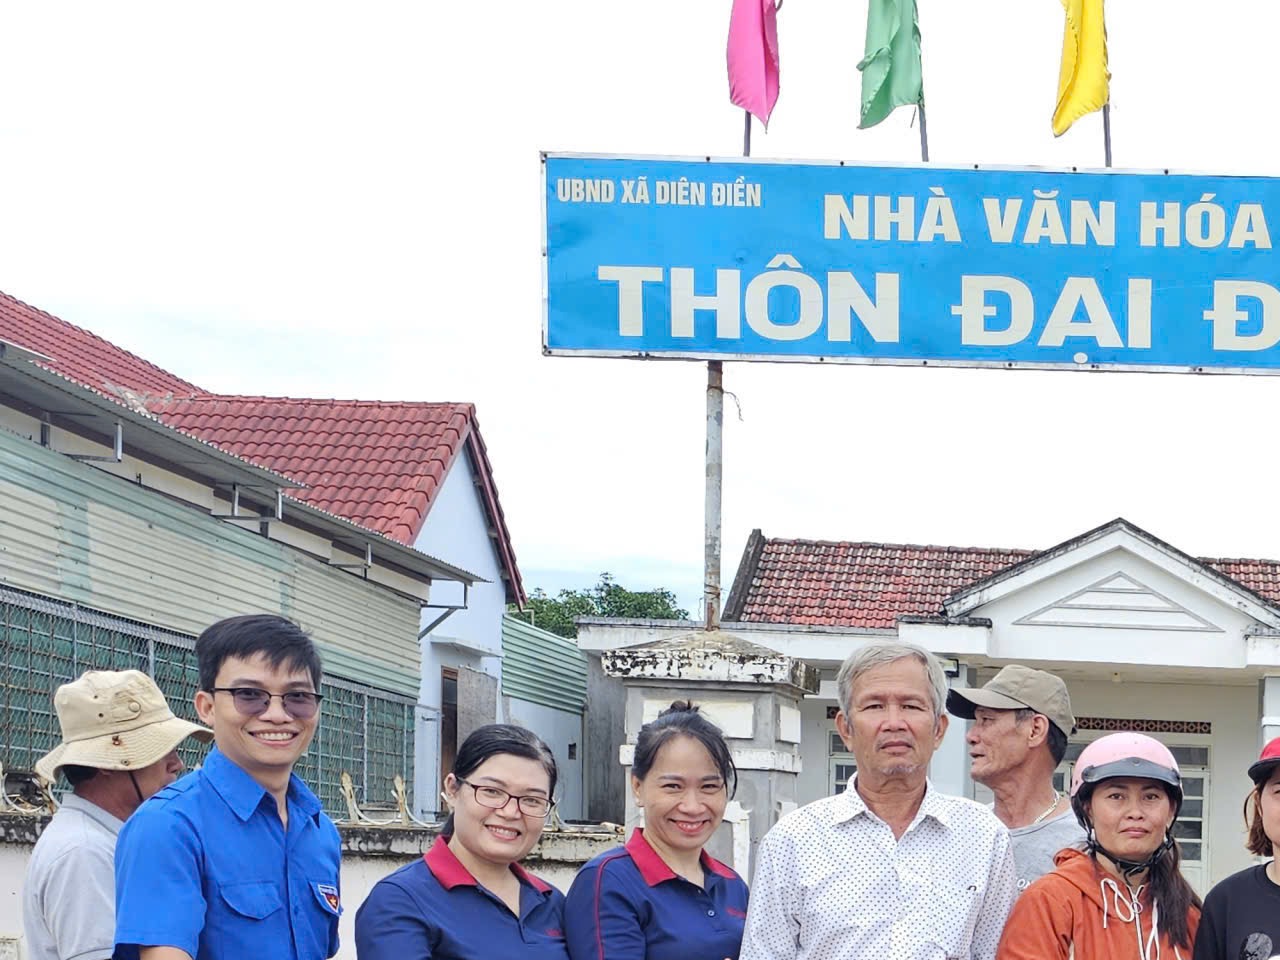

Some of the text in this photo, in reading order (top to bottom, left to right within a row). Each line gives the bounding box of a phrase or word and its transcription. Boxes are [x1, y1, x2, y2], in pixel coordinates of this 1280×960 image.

[557, 175, 761, 207] UBND XÃ DIÊN ĐIỀN
[823, 187, 962, 243] NHÀ
[982, 189, 1116, 246] VĂN
[1139, 192, 1273, 249] HÓA
[597, 253, 900, 343] THÔN
[950, 274, 1153, 364] ĐẠI
